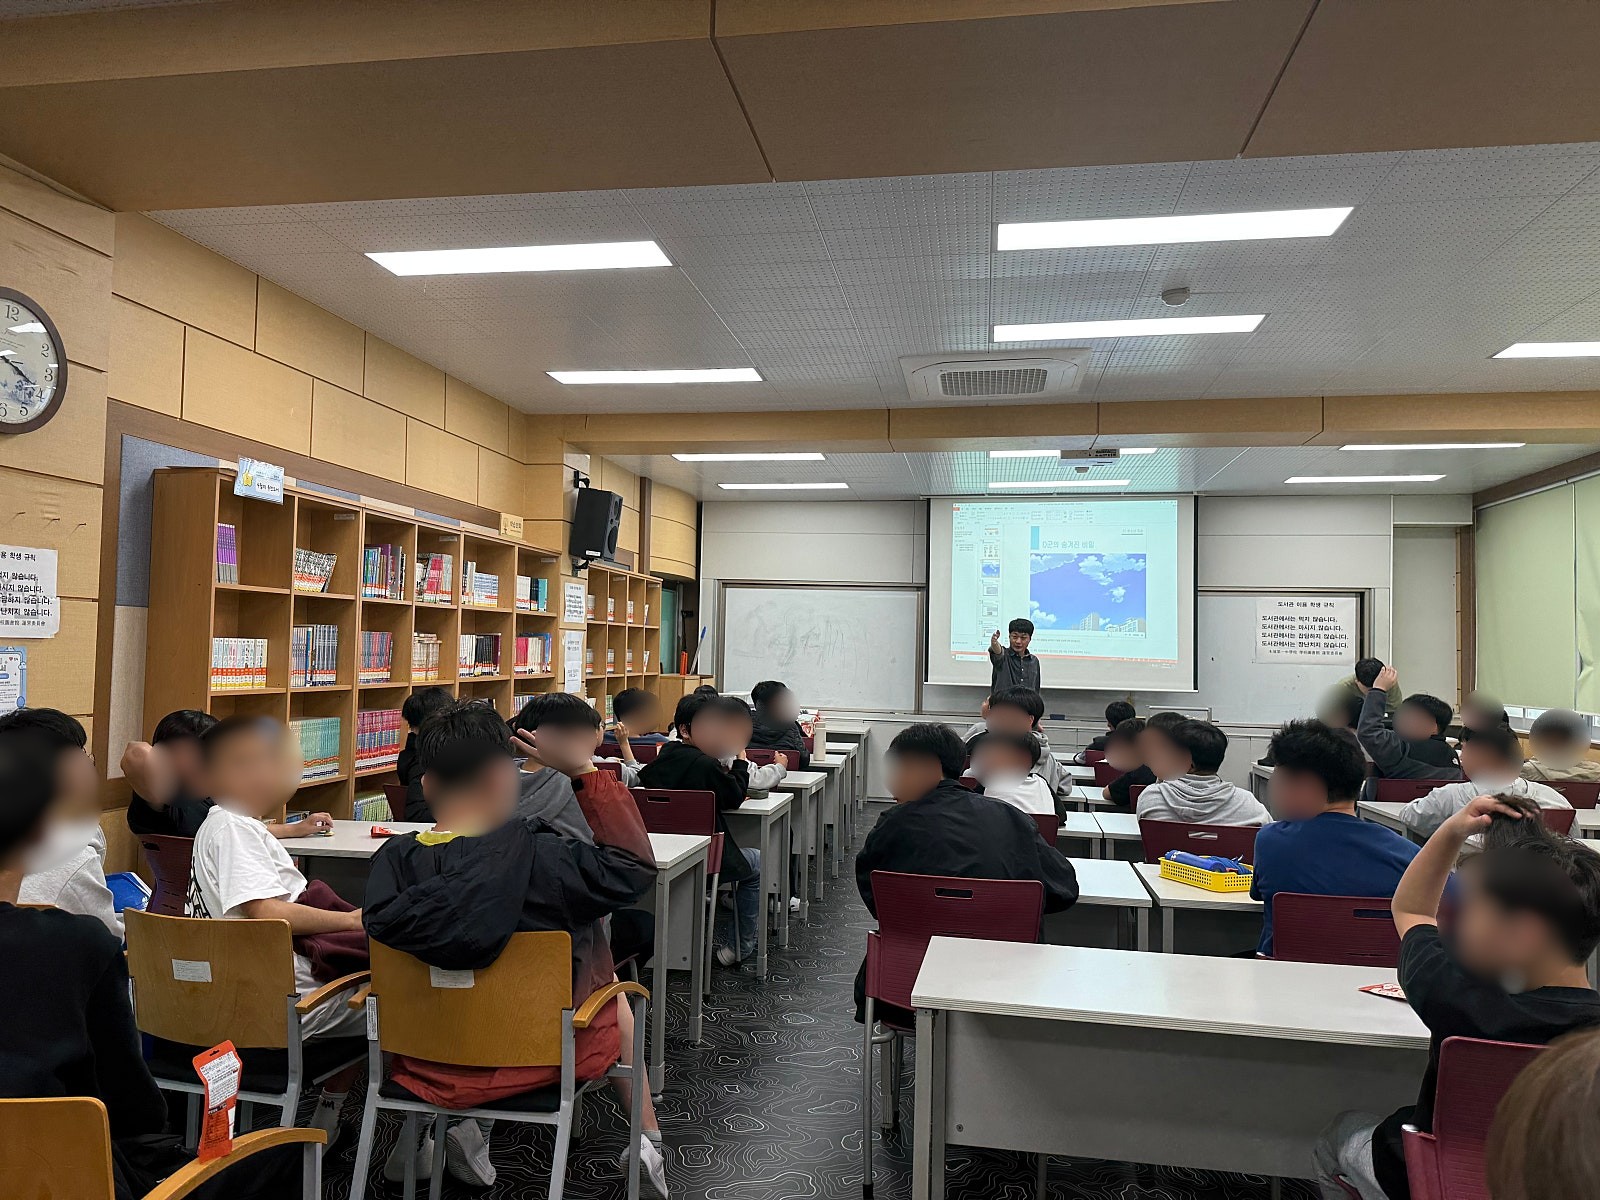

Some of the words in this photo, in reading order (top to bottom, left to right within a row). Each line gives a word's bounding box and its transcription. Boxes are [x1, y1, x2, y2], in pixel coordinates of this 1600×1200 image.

[5, 304, 20, 321] 12
[41, 343, 50, 357] 2
[44, 368, 54, 382] 3
[35, 387, 45, 402] 4
[19, 405, 29, 417] 5
[9, 552, 22, 560] 학생
[24, 553, 36, 562] 규칙
[11, 572, 39, 581] 않습니다.
[0, 584, 15, 592] 시지
[17, 585, 44, 593] 않습니다.
[0, 595, 21, 604] 담하지
[0, 607, 21, 616] 난치지
[23, 608, 53, 617] 않습니다.
[1318, 624, 1343, 632] 않습니다.
[1323, 633, 1349, 641] 않습니다.
[1323, 641, 1349, 649] 않습니다.
